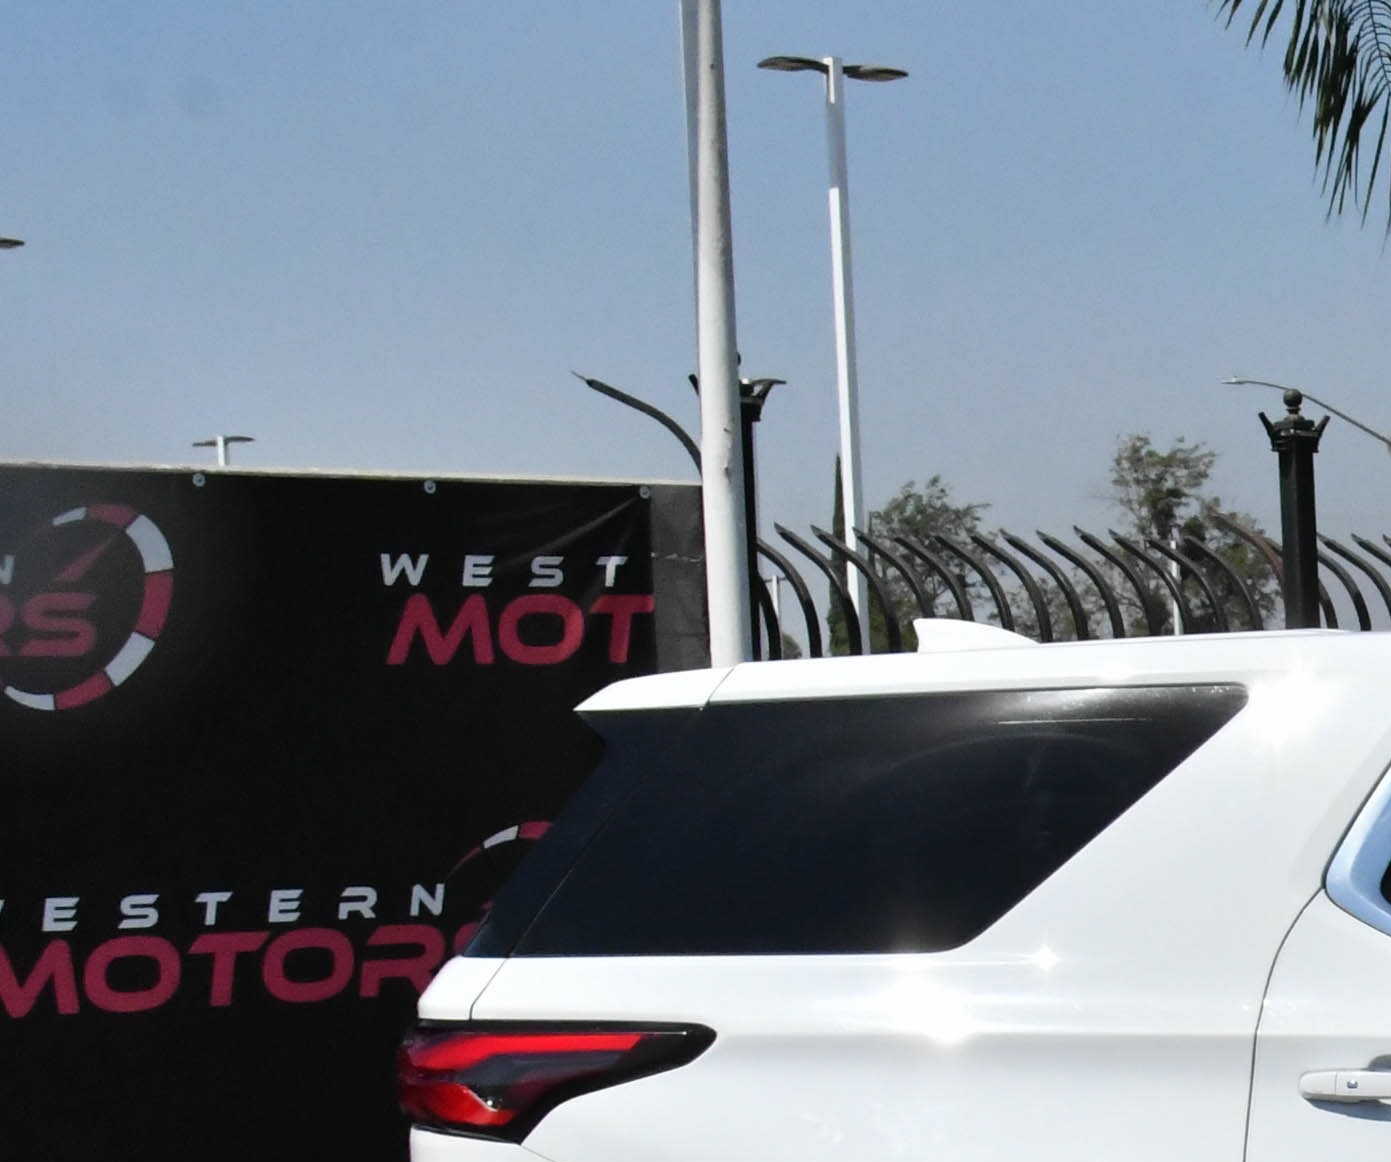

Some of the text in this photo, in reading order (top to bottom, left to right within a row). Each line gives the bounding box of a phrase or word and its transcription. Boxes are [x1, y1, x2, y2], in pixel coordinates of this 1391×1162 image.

[380, 553, 627, 587] WEST
[386, 593, 655, 665] MOT
[0, 883, 445, 932] ESTERN
